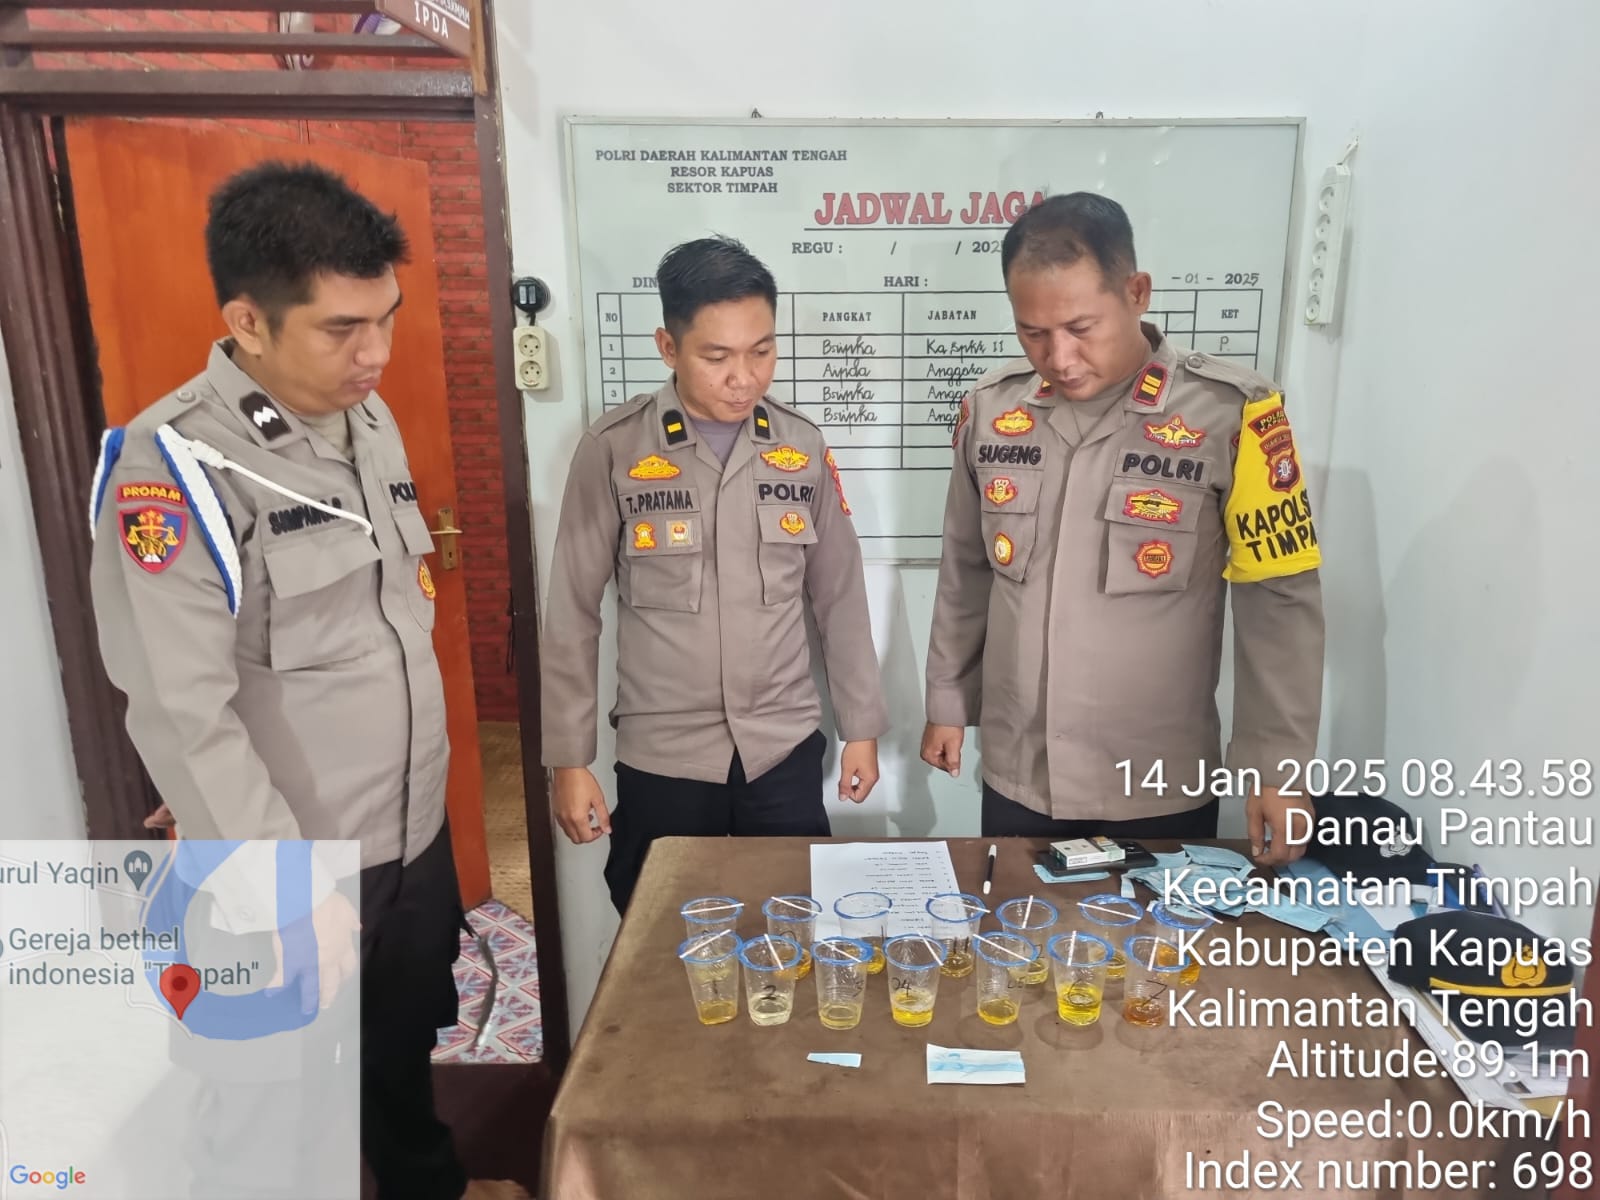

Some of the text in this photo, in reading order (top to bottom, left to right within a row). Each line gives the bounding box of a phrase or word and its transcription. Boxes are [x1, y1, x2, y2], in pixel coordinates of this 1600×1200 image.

[414, 0, 449, 40] IPDA
[595, 149, 847, 162] POLRI DAERAH KALIMANTAN TENGAH
[670, 165, 774, 178] RESOR KAPUAS
[667, 181, 778, 194] SEKTOR TIMPAH
[814, 192, 953, 225] JADWAL
[792, 242, 834, 254] REGU
[972, 241, 1003, 254] 202
[632, 277, 659, 288] DIN
[883, 276, 920, 288] HARI
[1224, 273, 1260, 287] 2025
[605, 312, 618, 323] NO
[822, 312, 872, 322] PANGKAT
[927, 310, 977, 321] JABATAN
[1221, 309, 1239, 319] KET
[609, 367, 616, 375] 2
[611, 390, 617, 398] 3
[977, 444, 1042, 466] SUGENG
[1122, 452, 1204, 482] POLRI
[122, 486, 181, 502] PROPAM
[758, 483, 813, 504] POLRI
[626, 490, 693, 514] T.PRATAMA
[1236, 488, 1312, 540] KAPOLS
[1246, 522, 1318, 562] TIMPA
[763, 985, 778, 1001] 2
